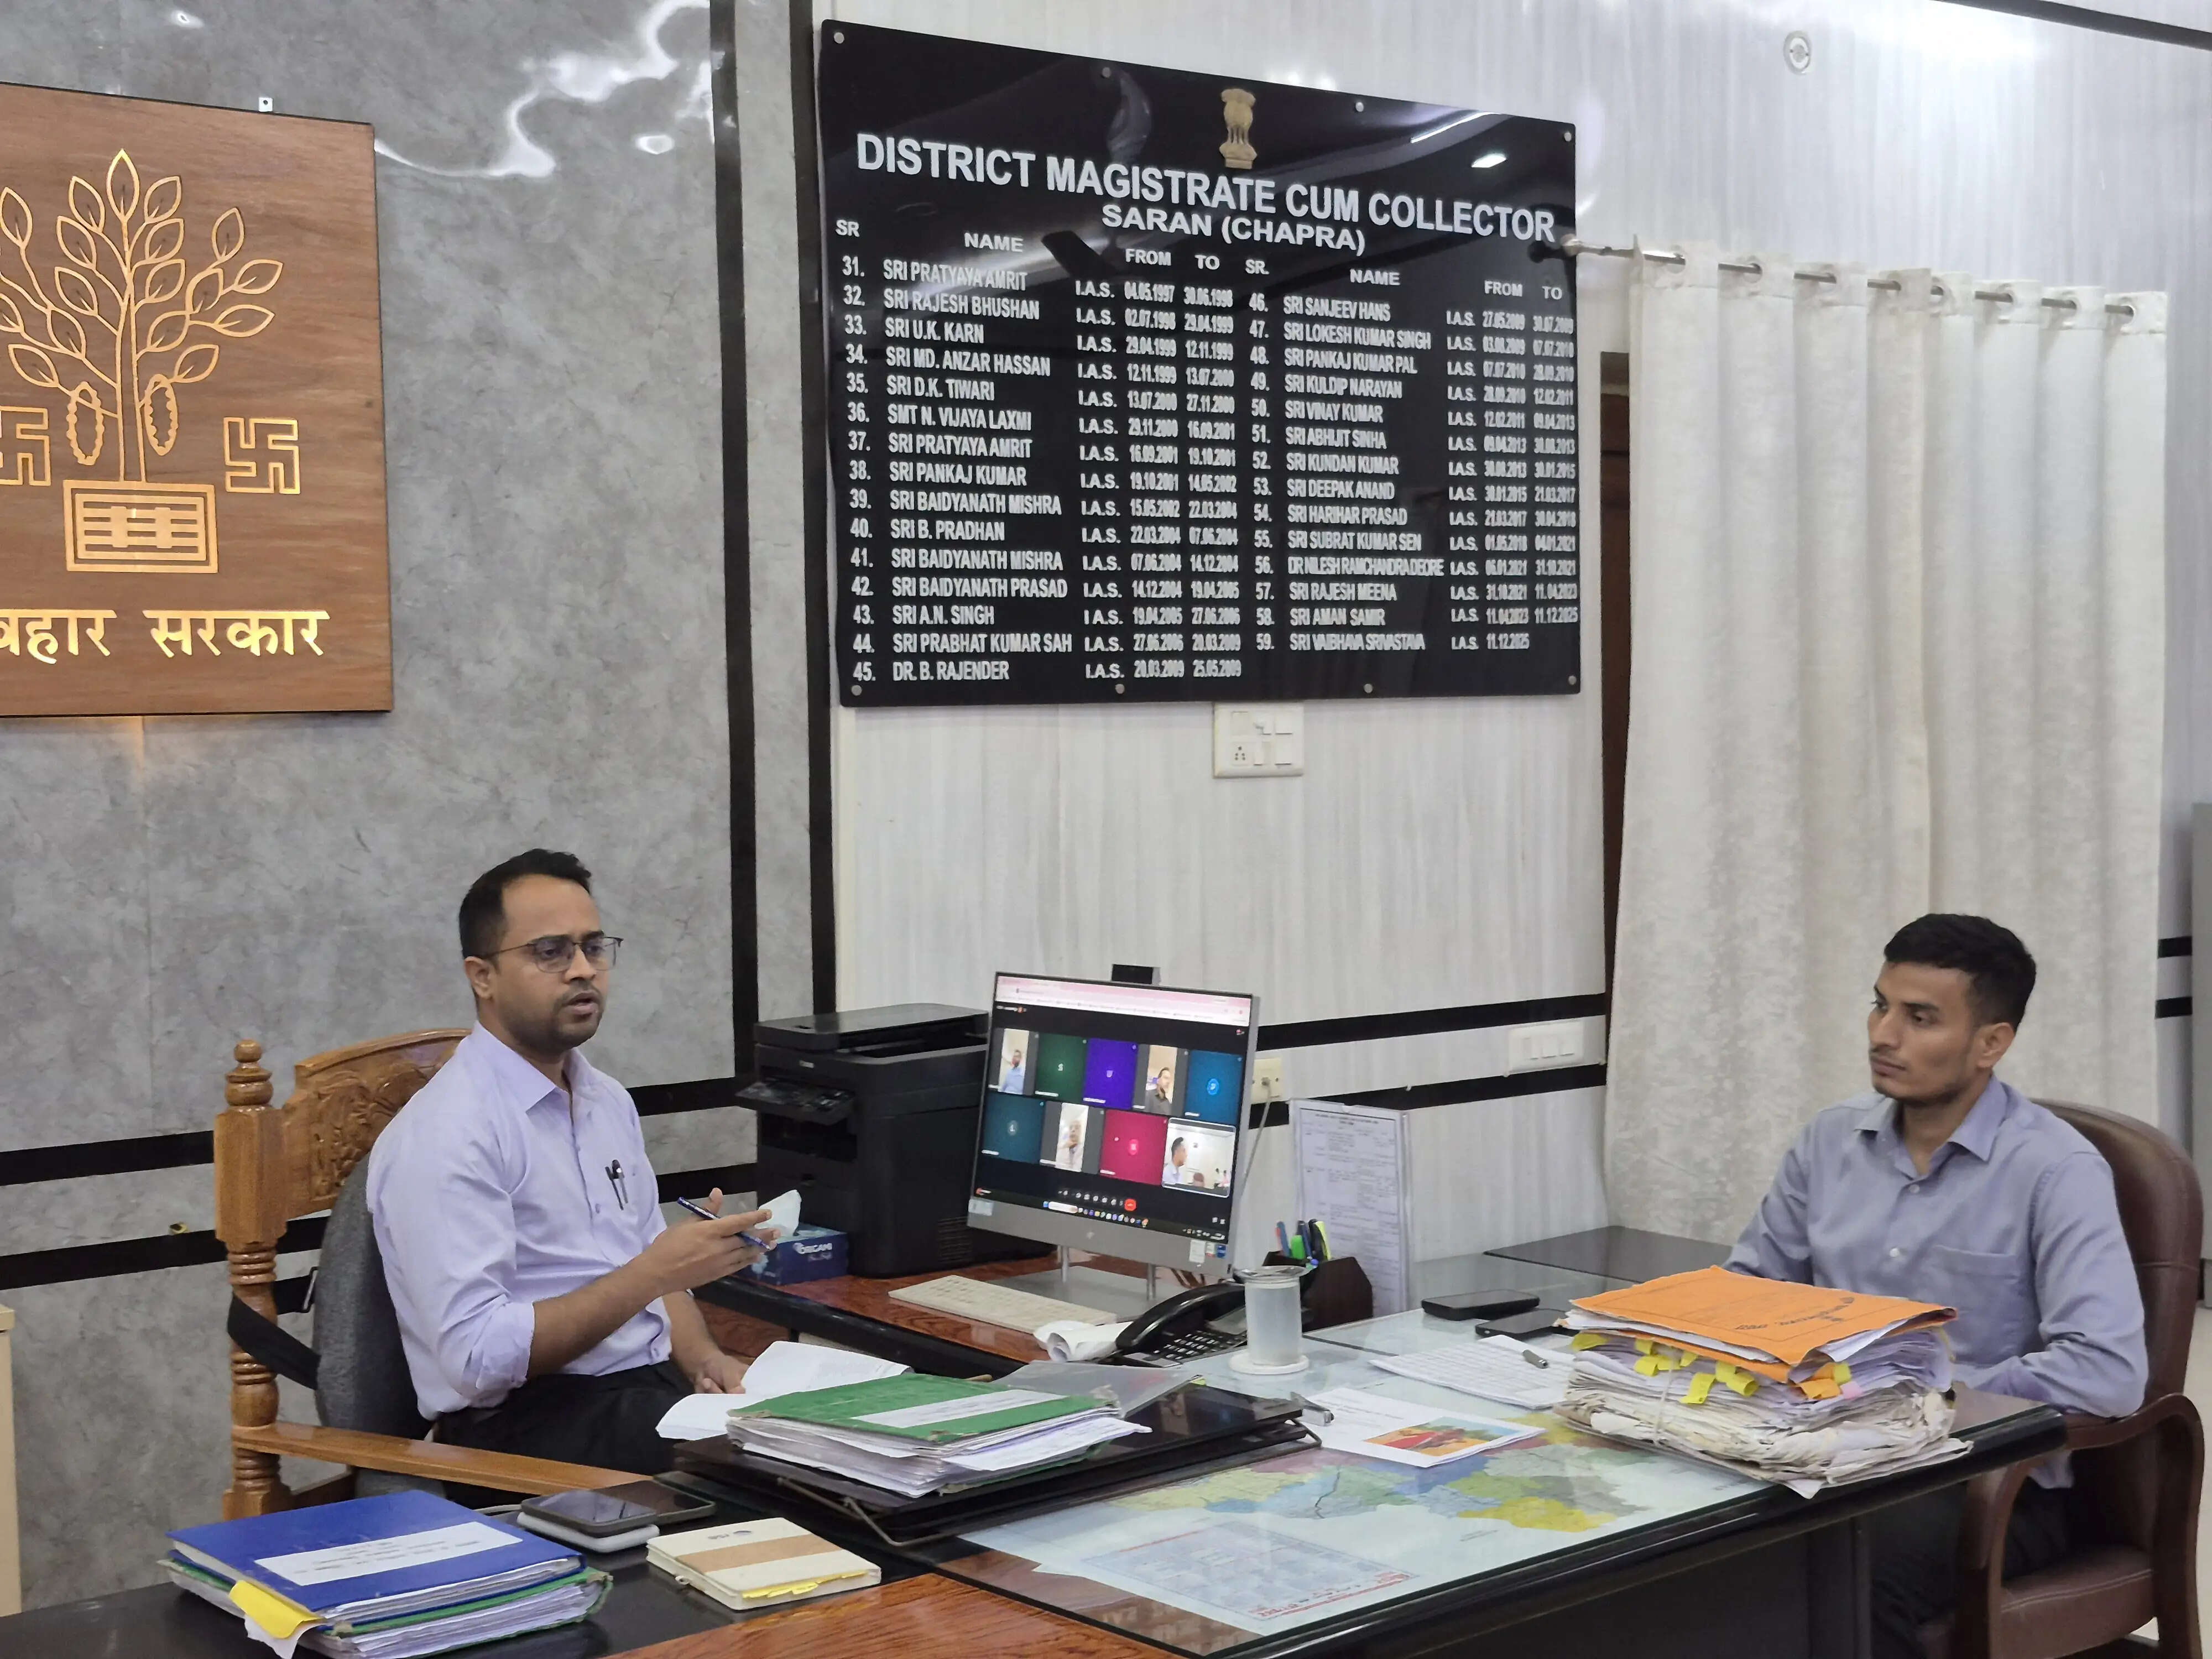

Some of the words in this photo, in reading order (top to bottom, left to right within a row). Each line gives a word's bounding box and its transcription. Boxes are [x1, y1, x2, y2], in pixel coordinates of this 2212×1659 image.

[857, 132, 1036, 187] DISTRICT
[1046, 155, 1276, 213] MAGISTRATE
[1285, 182, 1359, 222] CUM
[1368, 191, 1556, 243] COLLECTOR
[1102, 203, 1212, 236] SARAN
[1221, 215, 1365, 256] (CHAPRA)
[835, 219, 859, 237] SR
[964, 232, 1023, 252] NAME
[1125, 247, 1171, 265] FROM
[1194, 253, 1219, 270] TO
[842, 255, 864, 276] 31.
[883, 259, 907, 282] SRI
[910, 261, 982, 288] PRATYAYA
[984, 267, 1027, 291] AMRIT
[1075, 280, 1115, 298] I.A.S.
[1245, 258, 1269, 274] SR.
[1349, 268, 1400, 285] NAME
[1484, 280, 1522, 296] FROM
[1542, 286, 1562, 299] TO
[843, 284, 865, 306] 32.
[883, 288, 909, 310] SRI
[911, 290, 968, 315] RAJESH
[971, 295, 1040, 320] BHUSHAN
[1076, 307, 1115, 325] I.A.S.
[1249, 291, 1268, 312] 46.
[1283, 295, 1303, 314] SRI
[1305, 296, 1358, 319] SANJEEV
[1358, 301, 1390, 321] HANS
[844, 313, 867, 335] 33.
[885, 315, 909, 338] SRI
[912, 319, 941, 340] U.K.
[943, 321, 984, 343] KARN
[1077, 335, 1117, 352] I.A.S.
[1249, 319, 1269, 338] 47.
[1284, 321, 1303, 341] SRI
[1305, 323, 1352, 343] LOKESH
[1354, 326, 1395, 348] KUMAR
[1396, 330, 1431, 349] SINGH
[845, 341, 867, 364] 34.
[885, 345, 910, 367] SRI
[913, 347, 940, 368] MD.
[942, 349, 990, 372] ANZAR
[993, 353, 1050, 376] HASSAN
[1077, 363, 1117, 380] I.A.S.
[1250, 345, 1269, 364] 48.
[1284, 347, 1304, 367] SRI
[1305, 348, 1351, 370] PANKAJ
[1353, 352, 1395, 372] KUMAR
[1395, 354, 1417, 374] PAL
[846, 371, 868, 393] 35.
[886, 374, 911, 395] SRI
[914, 375, 943, 398] D.K.
[945, 378, 994, 400] TIWARI
[1078, 389, 1117, 407] I.A.S.
[1250, 371, 1270, 391] 49.
[1284, 373, 1305, 393] SRI
[1306, 374, 1348, 395] KULDIP
[1349, 377, 1402, 398] NARAYAN
[847, 400, 869, 422] 36.
[887, 402, 918, 424] SMT
[921, 405, 936, 425] N.
[938, 406, 987, 429] VIJAYA
[988, 409, 1031, 431] LAXMI
[1078, 417, 1118, 434] I.A.S.
[1251, 398, 1270, 417] 50.
[1285, 399, 1305, 419] SRI
[1306, 401, 1340, 421] VINAY
[1342, 402, 1383, 422] KUMAR
[848, 429, 870, 451] 37.
[888, 431, 913, 453] SRI
[916, 433, 988, 456] PRATYAYA
[988, 437, 1032, 458] AMRIT
[1079, 445, 1119, 461] I.A.S.
[1251, 424, 1271, 444] 51.
[1285, 426, 1306, 445] SRI
[1351, 429, 1387, 449] SINHA
[849, 459, 871, 480] 38.
[889, 461, 913, 481] SRI
[916, 462, 972, 484] PANKAJ
[975, 465, 1026, 486] KUMAR
[1080, 472, 1119, 489] I.A.S.
[1286, 451, 1306, 471] SRI
[1357, 455, 1399, 474] KUMAR
[849, 487, 871, 509] 39.
[889, 488, 914, 510] SRI
[917, 490, 1006, 513] BAIDYANATH
[1008, 494, 1062, 515] MISHRA
[1081, 499, 1120, 516] I.A.S.
[1253, 477, 1272, 495] 53.
[1286, 478, 1306, 497] SRI
[1308, 478, 1354, 498] DEEPAK
[1253, 503, 1272, 522] 54.
[1287, 503, 1307, 523] SRI
[1308, 504, 1360, 524] HARIHAR
[1361, 506, 1407, 525] PRASAD
[849, 517, 872, 538] 40.
[890, 518, 915, 539] SRI
[917, 519, 932, 539] B.
[935, 519, 1004, 541] PRADHAN
[1081, 527, 1121, 543] I.A.S.
[1254, 529, 1272, 548] 55.
[1287, 530, 1308, 548] SRI
[1309, 530, 1355, 549] SUBRAT
[1356, 531, 1397, 550] KUMAR
[850, 547, 873, 567] 41.
[891, 547, 915, 568] SRI
[918, 548, 1007, 569] BAIDYANATH
[1010, 550, 1063, 570] MISHRA
[1082, 555, 1121, 571] I.A.S.
[1254, 555, 1274, 574] 56.
[891, 576, 916, 596] SRI
[919, 576, 1008, 597] BAIDYANATH
[1010, 577, 1067, 597] PRASAD
[1083, 581, 1122, 598] I.A.S.
[1255, 581, 1274, 599] 57.
[1289, 581, 1309, 600] SRI
[1310, 582, 1355, 601] RAJESH
[1357, 582, 1397, 601] MEENA
[853, 603, 874, 624] 43.
[892, 604, 916, 624] SRI
[919, 604, 947, 624] A.N.
[950, 604, 994, 624] SINGH
[1290, 607, 1310, 625] SRI
[142, 610, 330, 658] सरकार
[853, 633, 875, 653] 44.
[893, 632, 917, 653] SRI
[920, 632, 988, 653] PRABHAT
[990, 632, 1041, 653] KUMAR
[1043, 633, 1072, 653] SAH
[1084, 636, 1124, 651] I.A.S.
[1256, 632, 1274, 650] 59.
[1289, 632, 1311, 650] SRI
[852, 661, 875, 681] 45.
[919, 660, 934, 680] B.
[936, 660, 1009, 680] RAJENDER
[1085, 662, 1124, 679] I.A.S.
